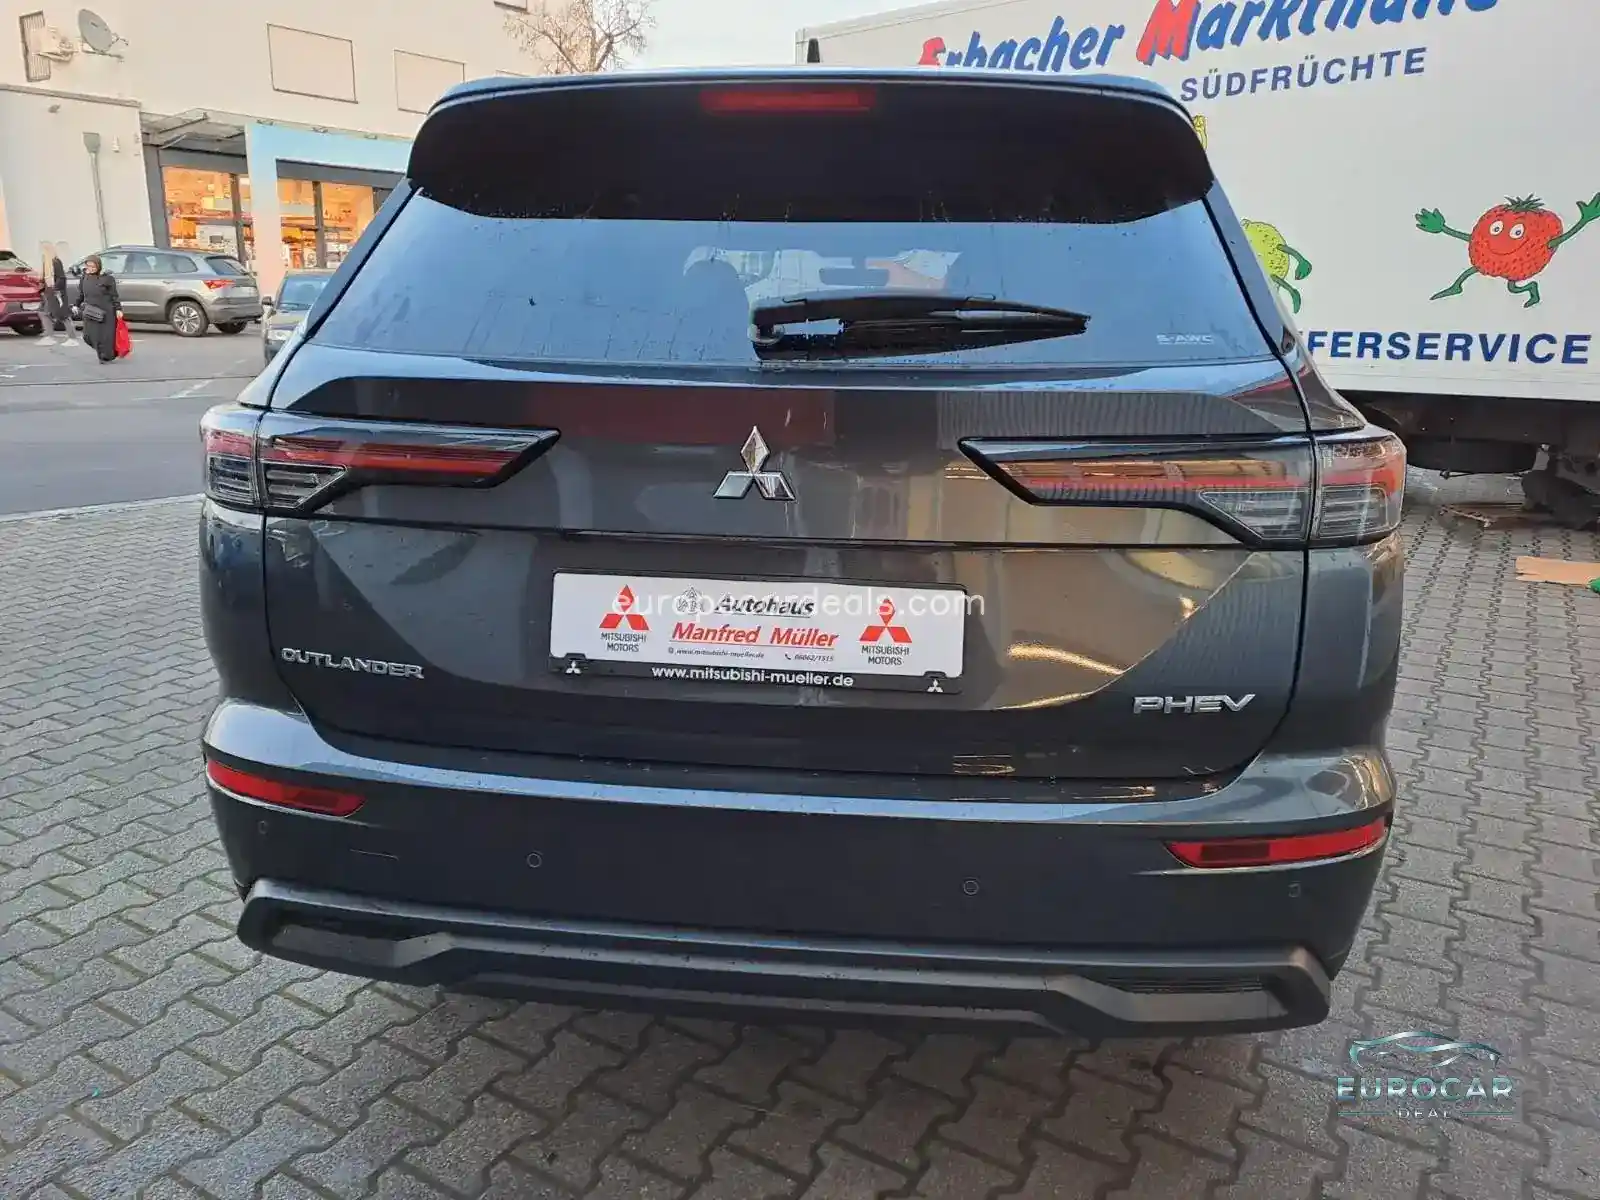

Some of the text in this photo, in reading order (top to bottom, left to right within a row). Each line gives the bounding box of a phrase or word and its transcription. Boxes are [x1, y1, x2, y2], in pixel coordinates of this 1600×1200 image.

[1180, 47, 1427, 101] SÜDFRÜCHTE
[1299, 331, 1592, 364] FERSERVICE
[714, 595, 815, 614] Autohaus
[601, 632, 647, 643] MITSUBISHI
[672, 621, 840, 648] Manfred Müller
[607, 643, 640, 653] MOTORS
[861, 645, 910, 656] MITSUBISHI
[281, 647, 425, 680] OUTLANDER
[868, 656, 902, 666] MOTORS
[651, 666, 854, 687] www.mitsubishi-mueller.de
[1133, 693, 1256, 714] PHEV
